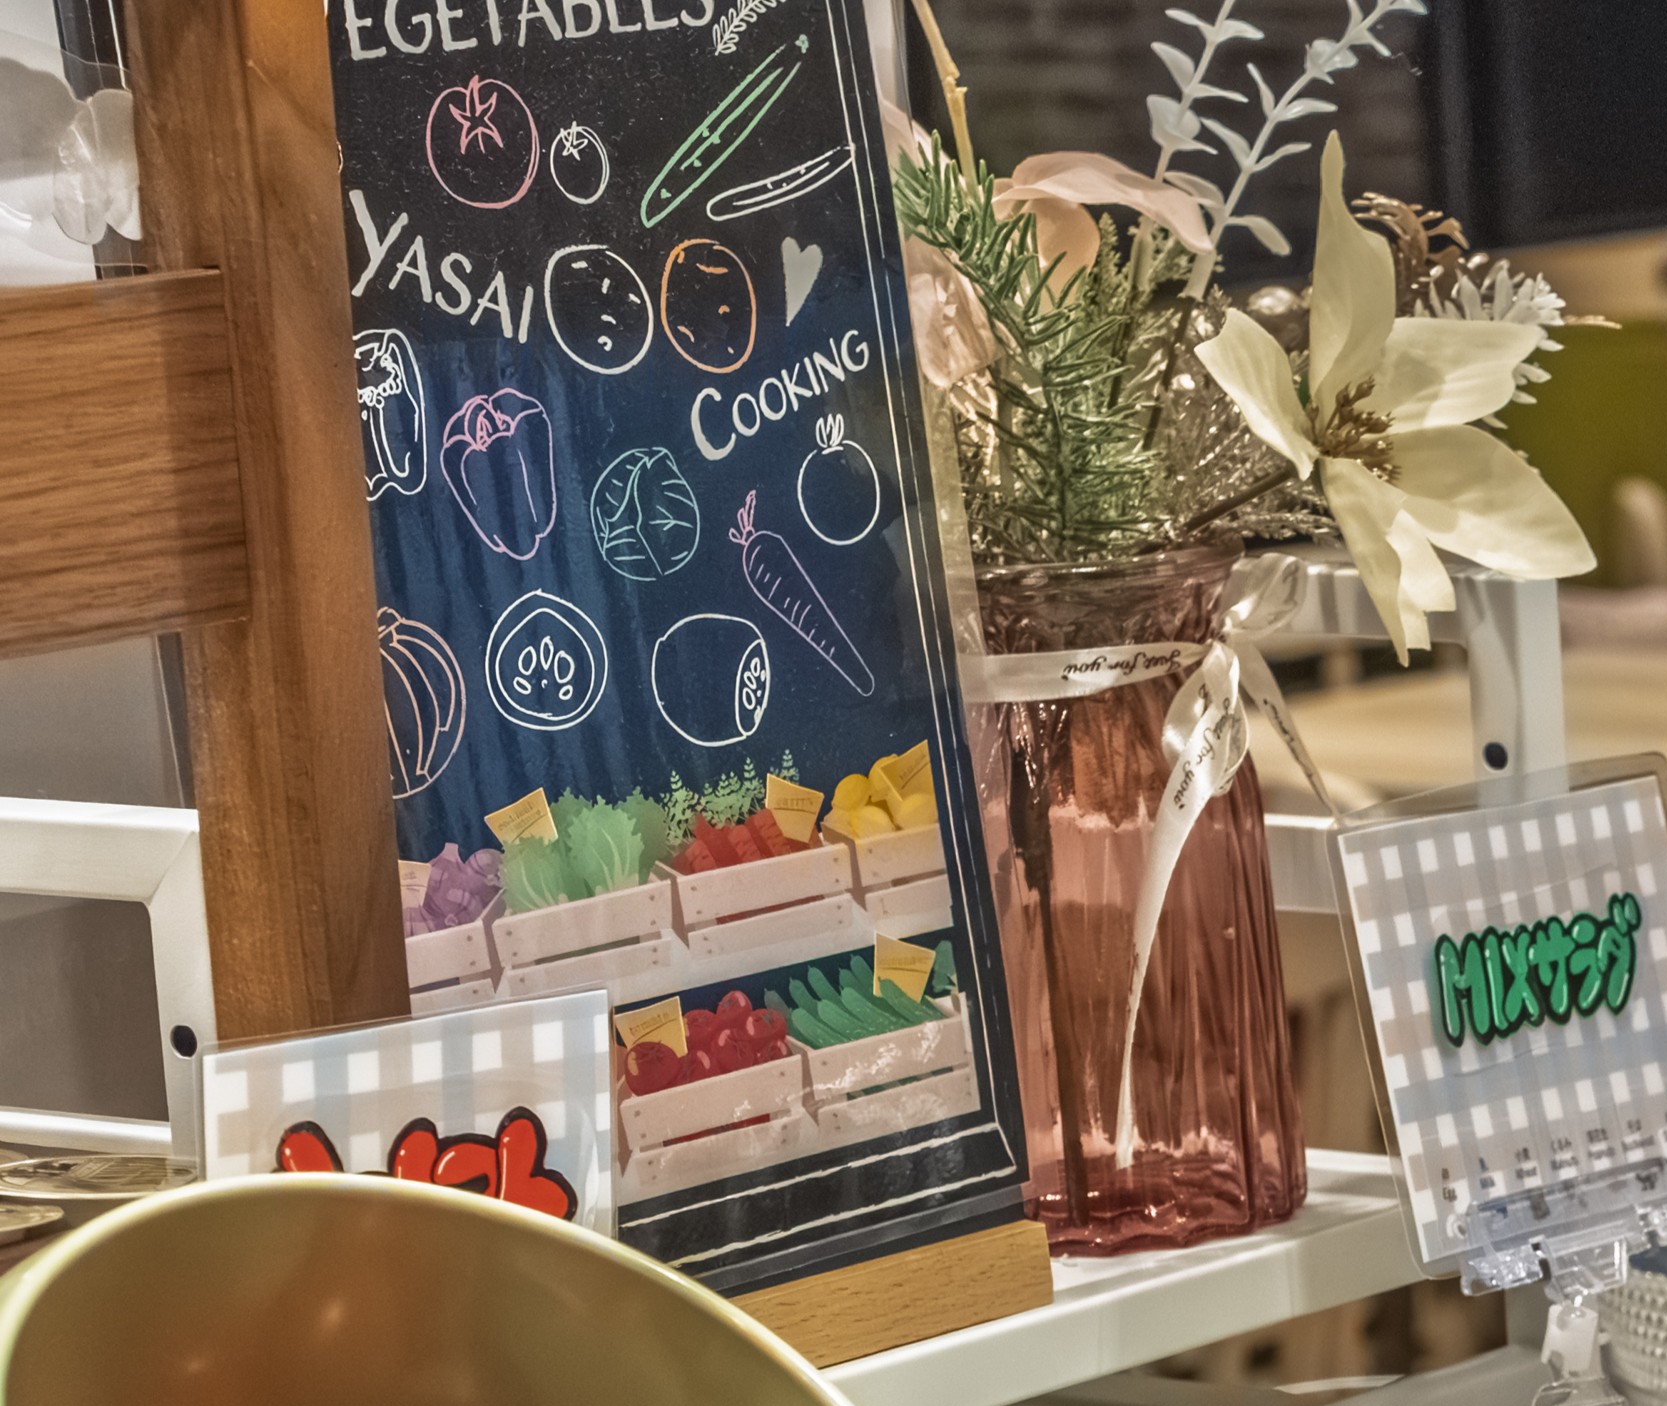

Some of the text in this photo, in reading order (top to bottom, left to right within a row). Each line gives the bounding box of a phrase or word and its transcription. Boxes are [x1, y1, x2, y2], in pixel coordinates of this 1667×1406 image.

[349, 189, 534, 344] YASAI
[691, 329, 870, 461] COOKING
[1435, 892, 1642, 1048] MIXサラダ
